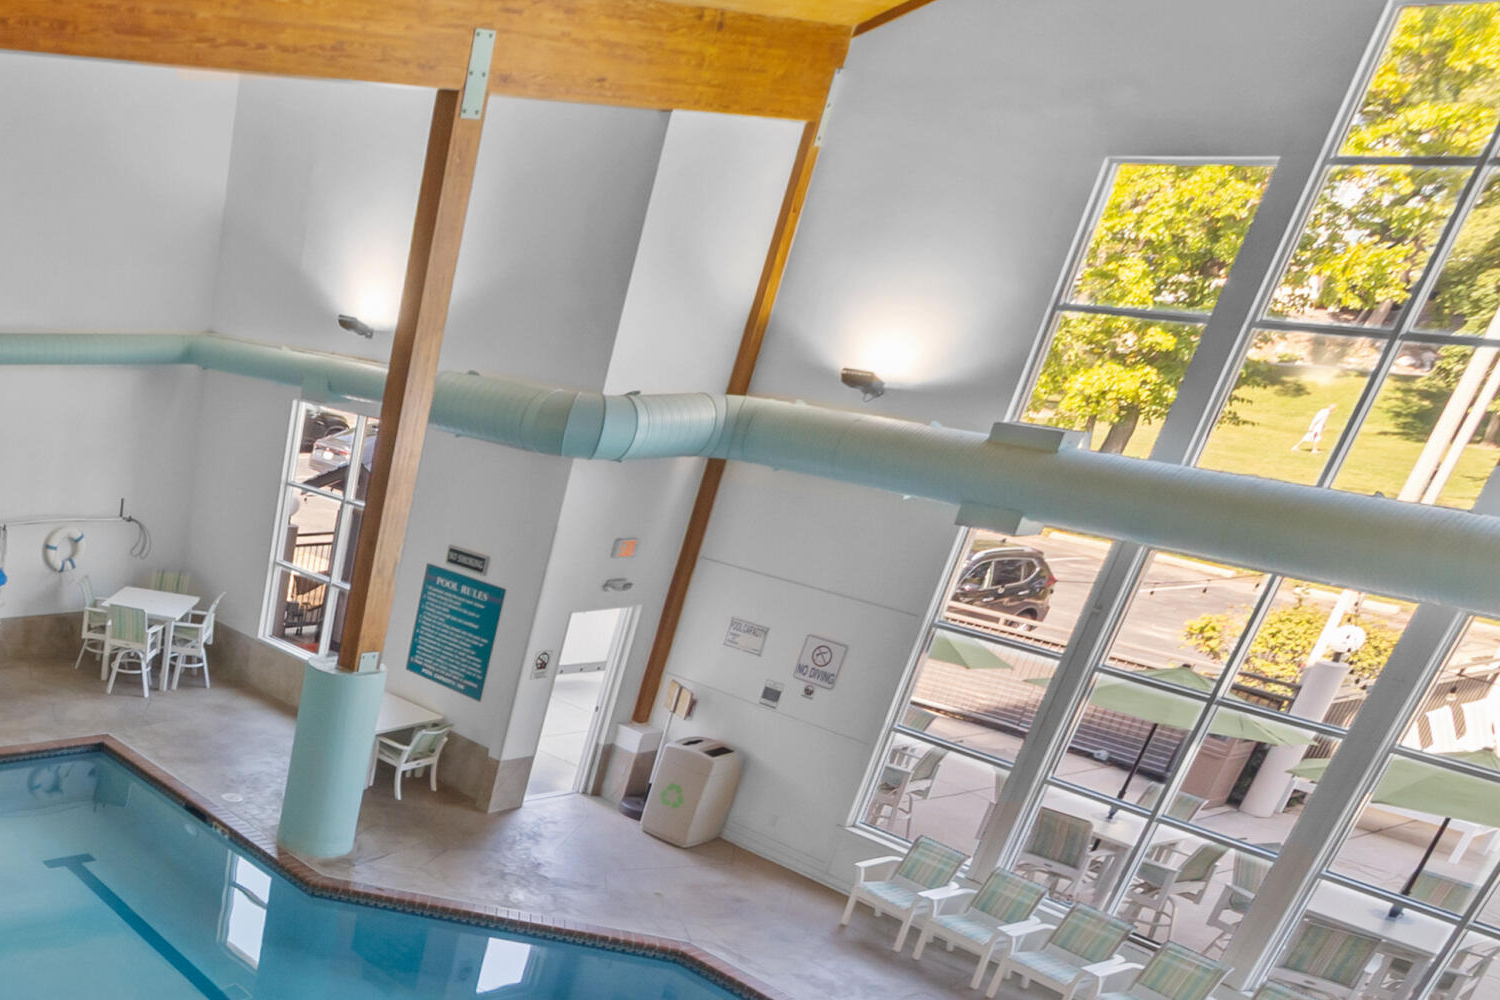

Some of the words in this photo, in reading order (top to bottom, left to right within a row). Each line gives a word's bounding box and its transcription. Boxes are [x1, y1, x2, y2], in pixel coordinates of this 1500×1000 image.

[436, 576, 458, 591] POOL
[460, 584, 488, 601] RULES
[731, 620, 742, 632] POOL
[797, 664, 808, 676] NO
[809, 667, 835, 685] DIVING
